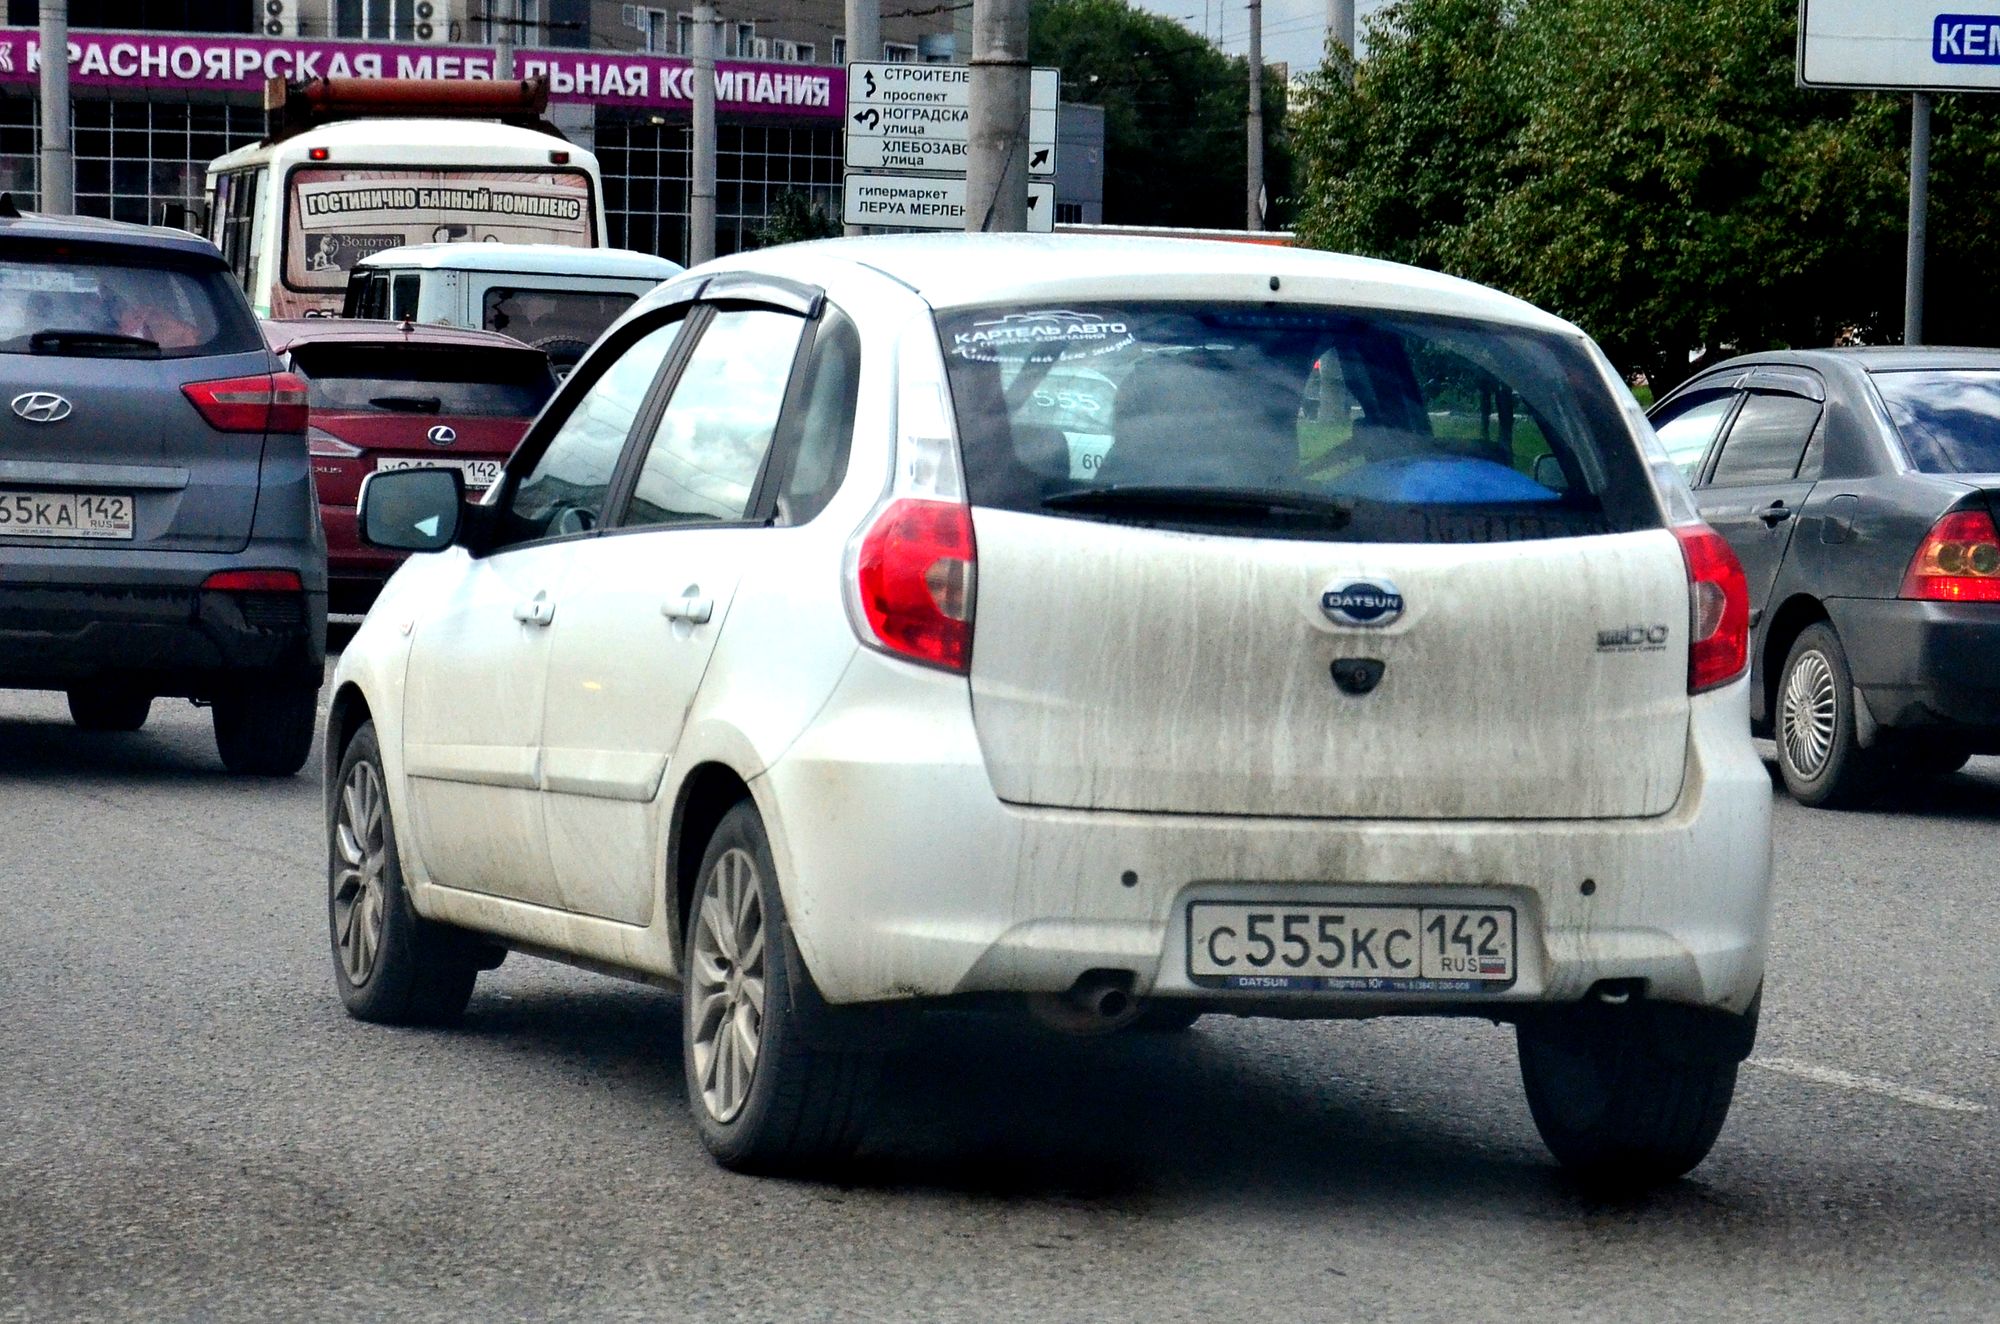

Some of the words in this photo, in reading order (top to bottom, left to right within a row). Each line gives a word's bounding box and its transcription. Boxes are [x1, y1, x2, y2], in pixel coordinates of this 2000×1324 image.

[397, 55, 648, 98] МЕБЛЬНАЯ
[883, 90, 948, 103] проспект
[882, 123, 925, 136] улица
[882, 156, 924, 167] улица
[858, 185, 948, 201] гипермаркет
[307, 188, 416, 215] ГОСТИНИЧНО
[418, 187, 490, 212] БАННЫЙ
[491, 192, 581, 220] КОМПЛЕКС
[858, 201, 905, 215] ЛЕРУА
[954, 325, 1061, 345] КАРТЕЛЬ
[1067, 323, 1128, 335] АВТО
[467, 461, 496, 478] 142
[80, 497, 124, 520] 142
[91, 519, 113, 529] RUS
[1328, 594, 1398, 608] DATSUN
[1207, 914, 1413, 970] С555КС
[1426, 914, 1500, 956] 142
[1441, 957, 1478, 973] RUS
[1239, 977, 1289, 988] DATSUN
